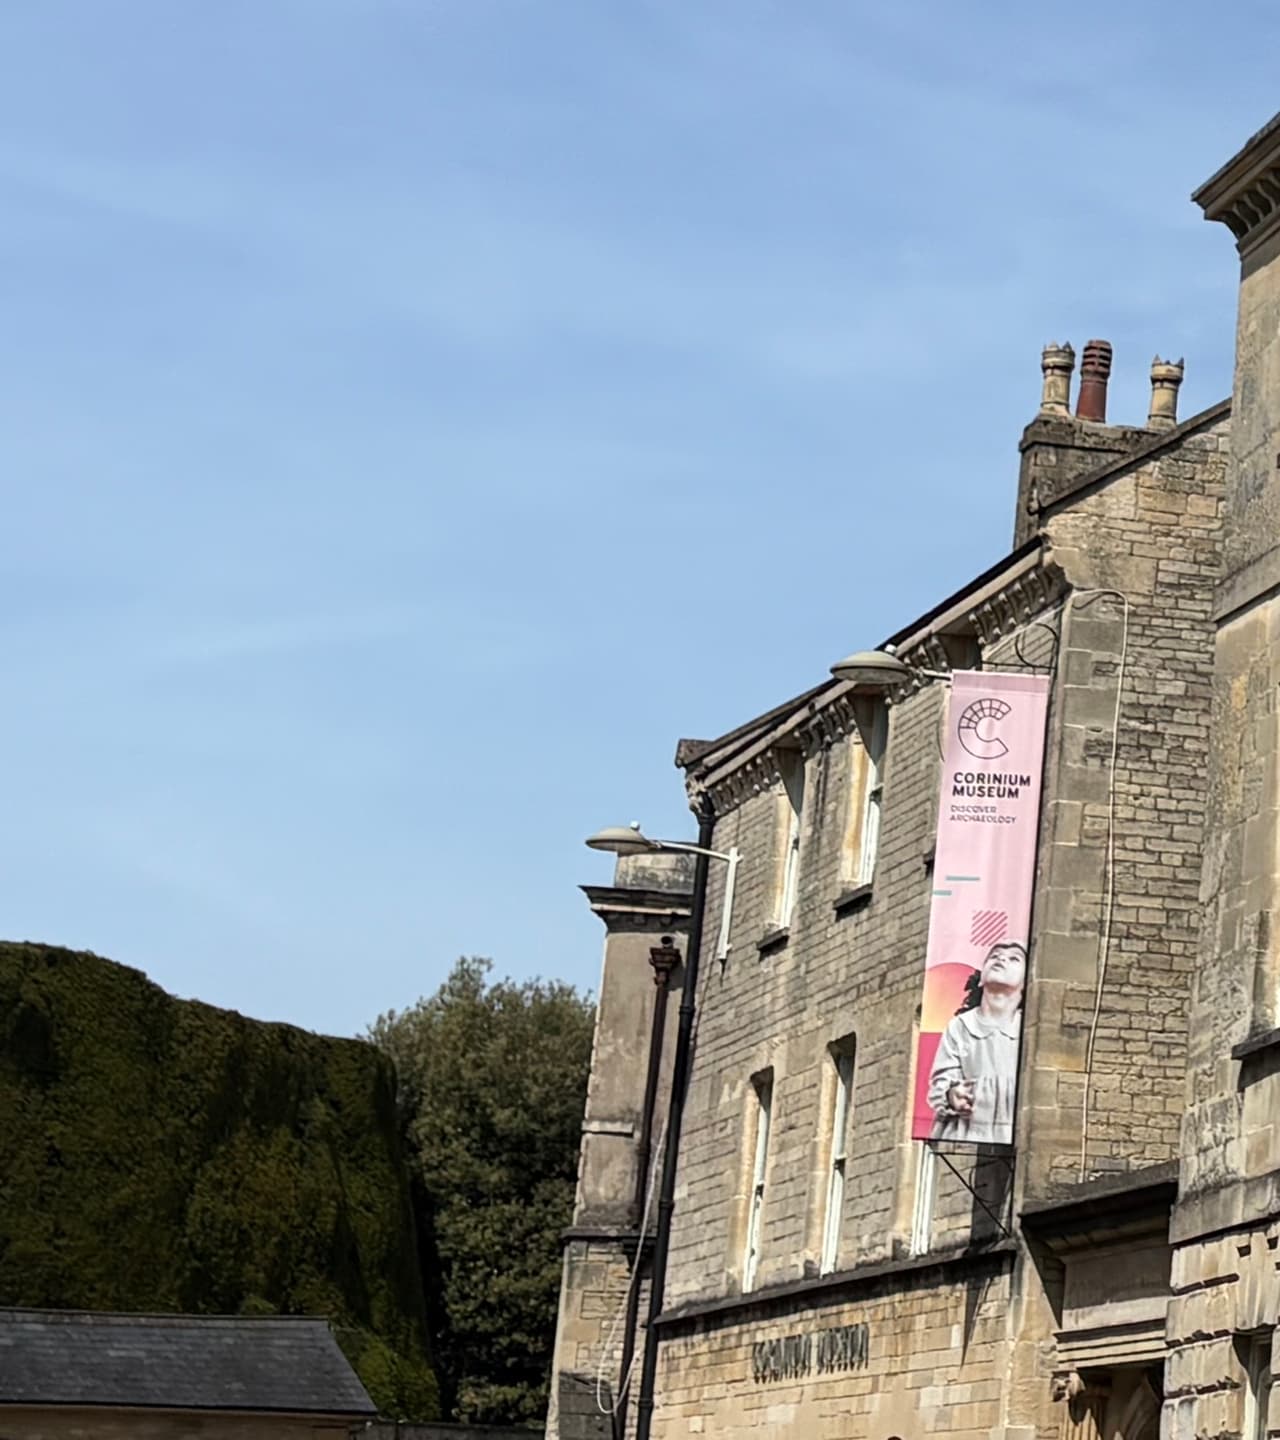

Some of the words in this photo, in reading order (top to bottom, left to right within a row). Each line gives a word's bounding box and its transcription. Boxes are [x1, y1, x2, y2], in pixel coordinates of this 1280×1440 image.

[953, 772, 1031, 786] CORINIUM
[952, 785, 1020, 798] MUSEUM
[950, 805, 997, 814] DISCOVER
[949, 814, 1017, 824] ARCHAEOLOGY
